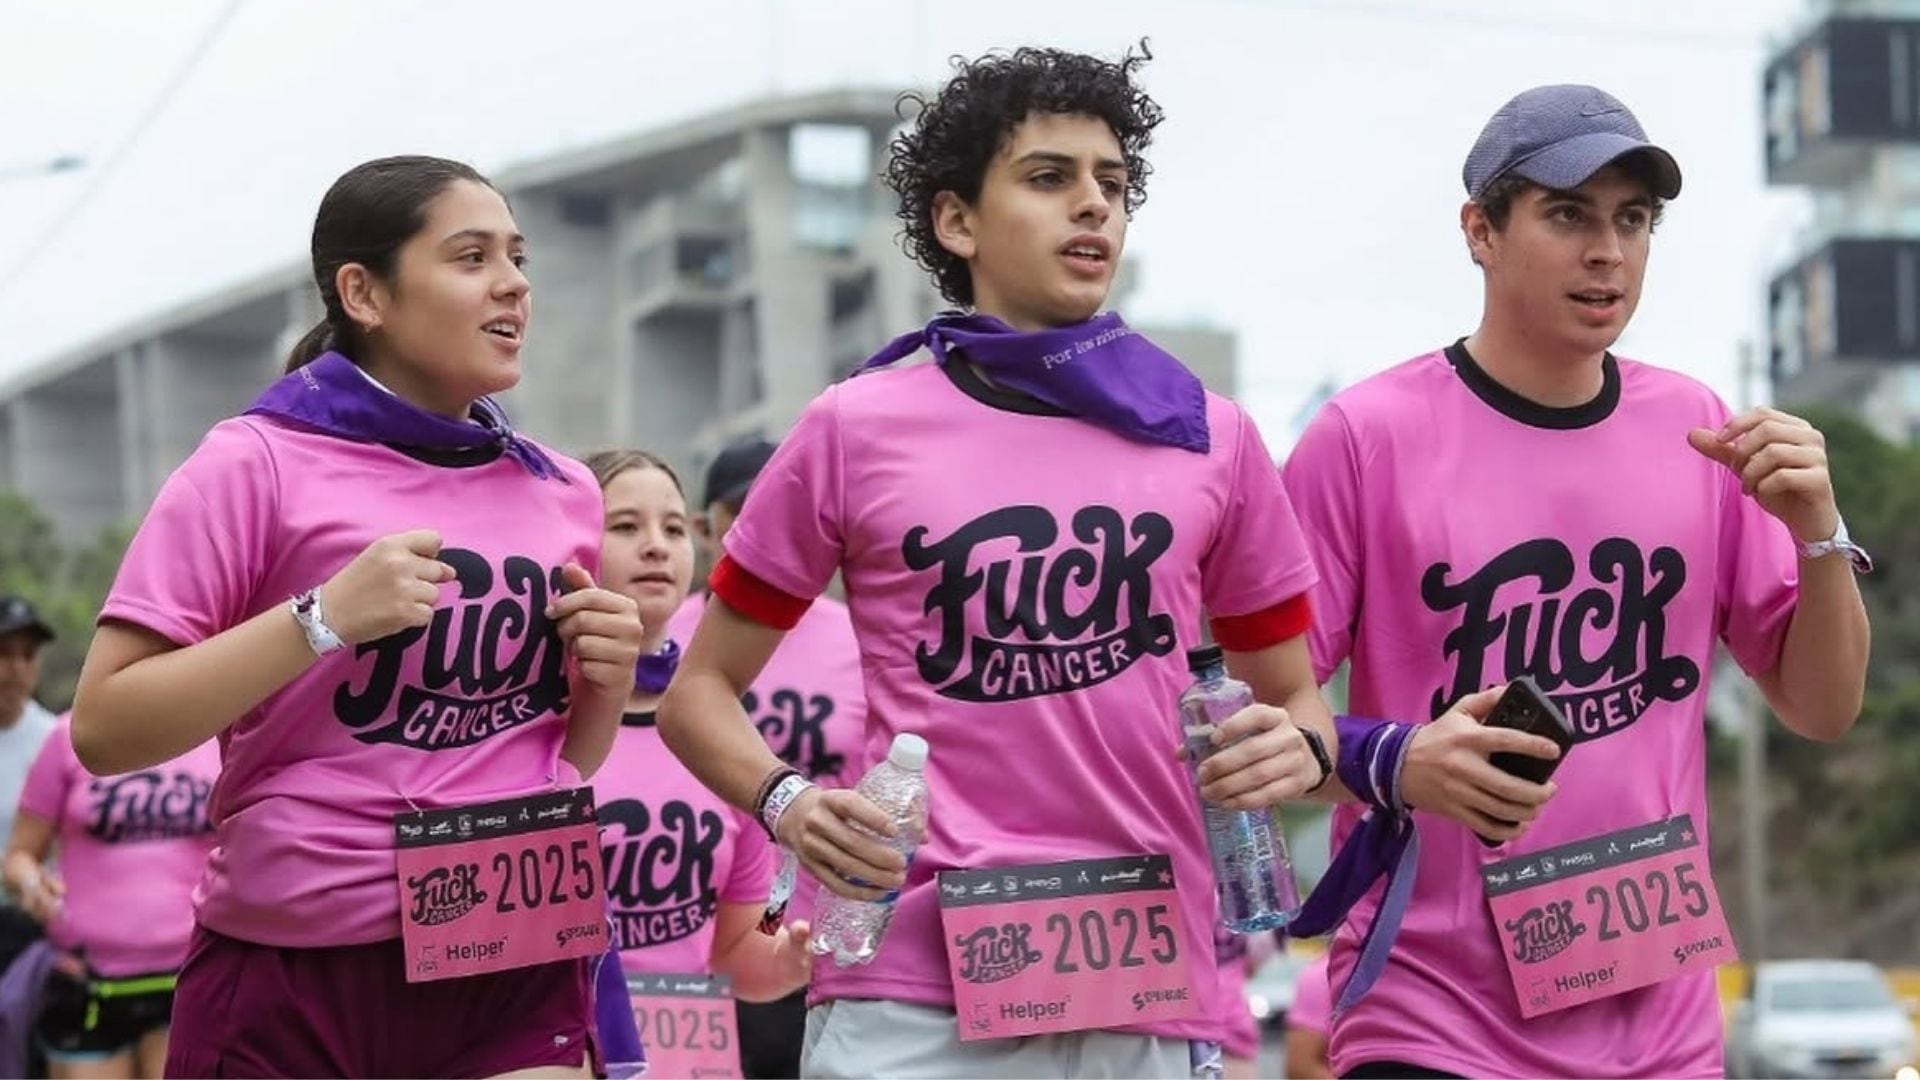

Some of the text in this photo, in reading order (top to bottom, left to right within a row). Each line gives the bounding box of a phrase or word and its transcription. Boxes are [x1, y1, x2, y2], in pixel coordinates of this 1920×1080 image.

[978, 641, 1132, 696] CANCER
[403, 694, 535, 746] CANCER
[492, 839, 596, 914] 2025
[1586, 862, 1709, 941] 2025
[446, 939, 506, 962] Helper
[613, 908, 702, 948] NCER
[1046, 904, 1178, 974] 2025
[1554, 965, 1615, 992] Helper
[636, 1006, 730, 1052] 2025
[999, 1000, 1068, 1022] Helper
